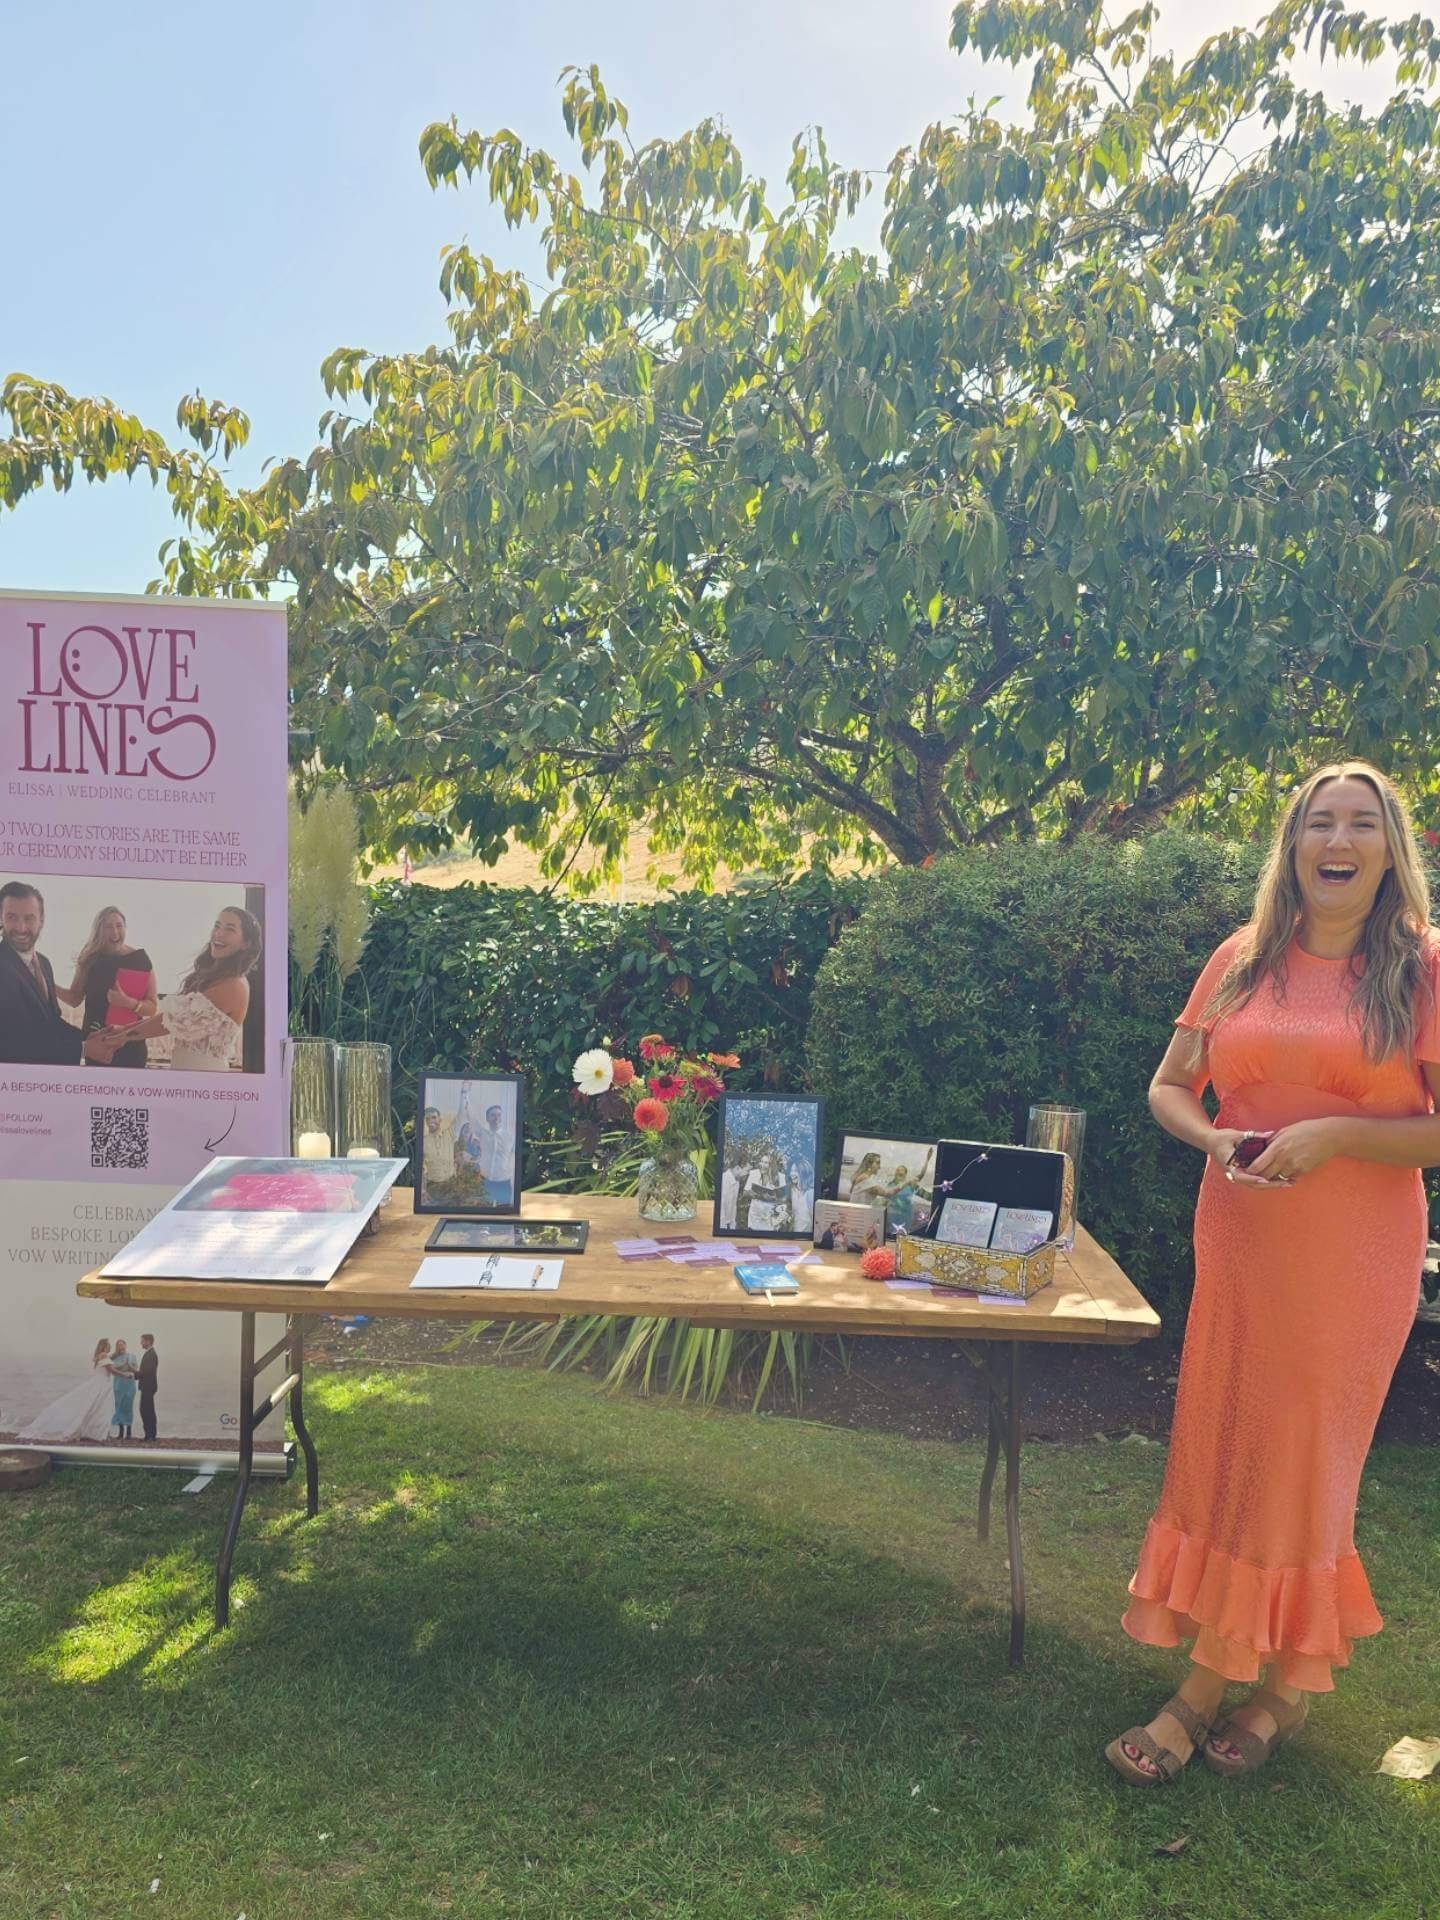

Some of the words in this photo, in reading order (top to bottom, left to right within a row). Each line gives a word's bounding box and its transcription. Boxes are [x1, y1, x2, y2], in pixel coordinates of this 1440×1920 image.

[26, 622, 199, 703] LOVE
[18, 699, 216, 781] LINES
[8, 782, 54, 797] ELISSA
[66, 785, 133, 800] WEDDING
[137, 788, 216, 804] CELEBRANT
[8, 821, 43, 837] TWO
[47, 823, 83, 840] LOVE
[85, 825, 140, 842] STORIES
[142, 828, 169, 843] ARE
[172, 829, 200, 845] THE
[202, 831, 240, 847] SAME
[18, 842, 97, 861] CEREMONY
[179, 850, 197, 865] BE
[200, 850, 247, 867] EITHER
[11, 1082, 62, 1094] BESPOKE
[65, 1084, 125, 1096] CEREMONY
[128, 1088, 135, 1097] &
[138, 1087, 210, 1100] VOW-WRITING
[212, 1090, 259, 1102] SESSION
[73, 1205, 161, 1222] CELEBRAN
[31, 1226, 102, 1243] BESPOKE
[108, 1229, 141, 1244] LOV
[8, 1249, 46, 1264] VOW
[220, 1413, 240, 1425] Go
